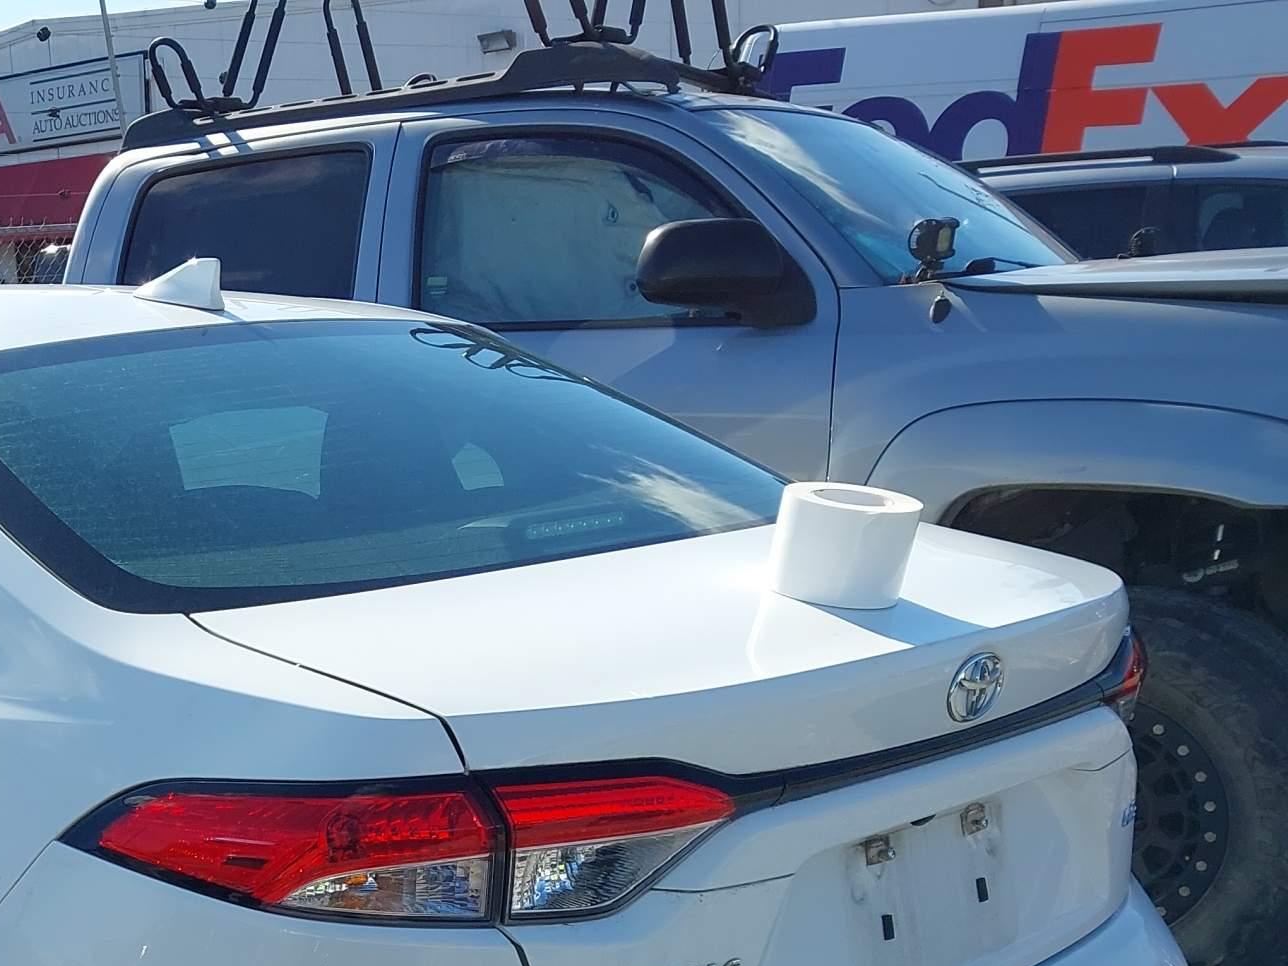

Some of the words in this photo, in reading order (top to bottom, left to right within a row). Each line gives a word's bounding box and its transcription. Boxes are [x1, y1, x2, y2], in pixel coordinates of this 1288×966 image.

[30, 78, 111, 105] INSURANC
[32, 114, 63, 135] AUTO
[64, 108, 120, 130] AUCTIONS
